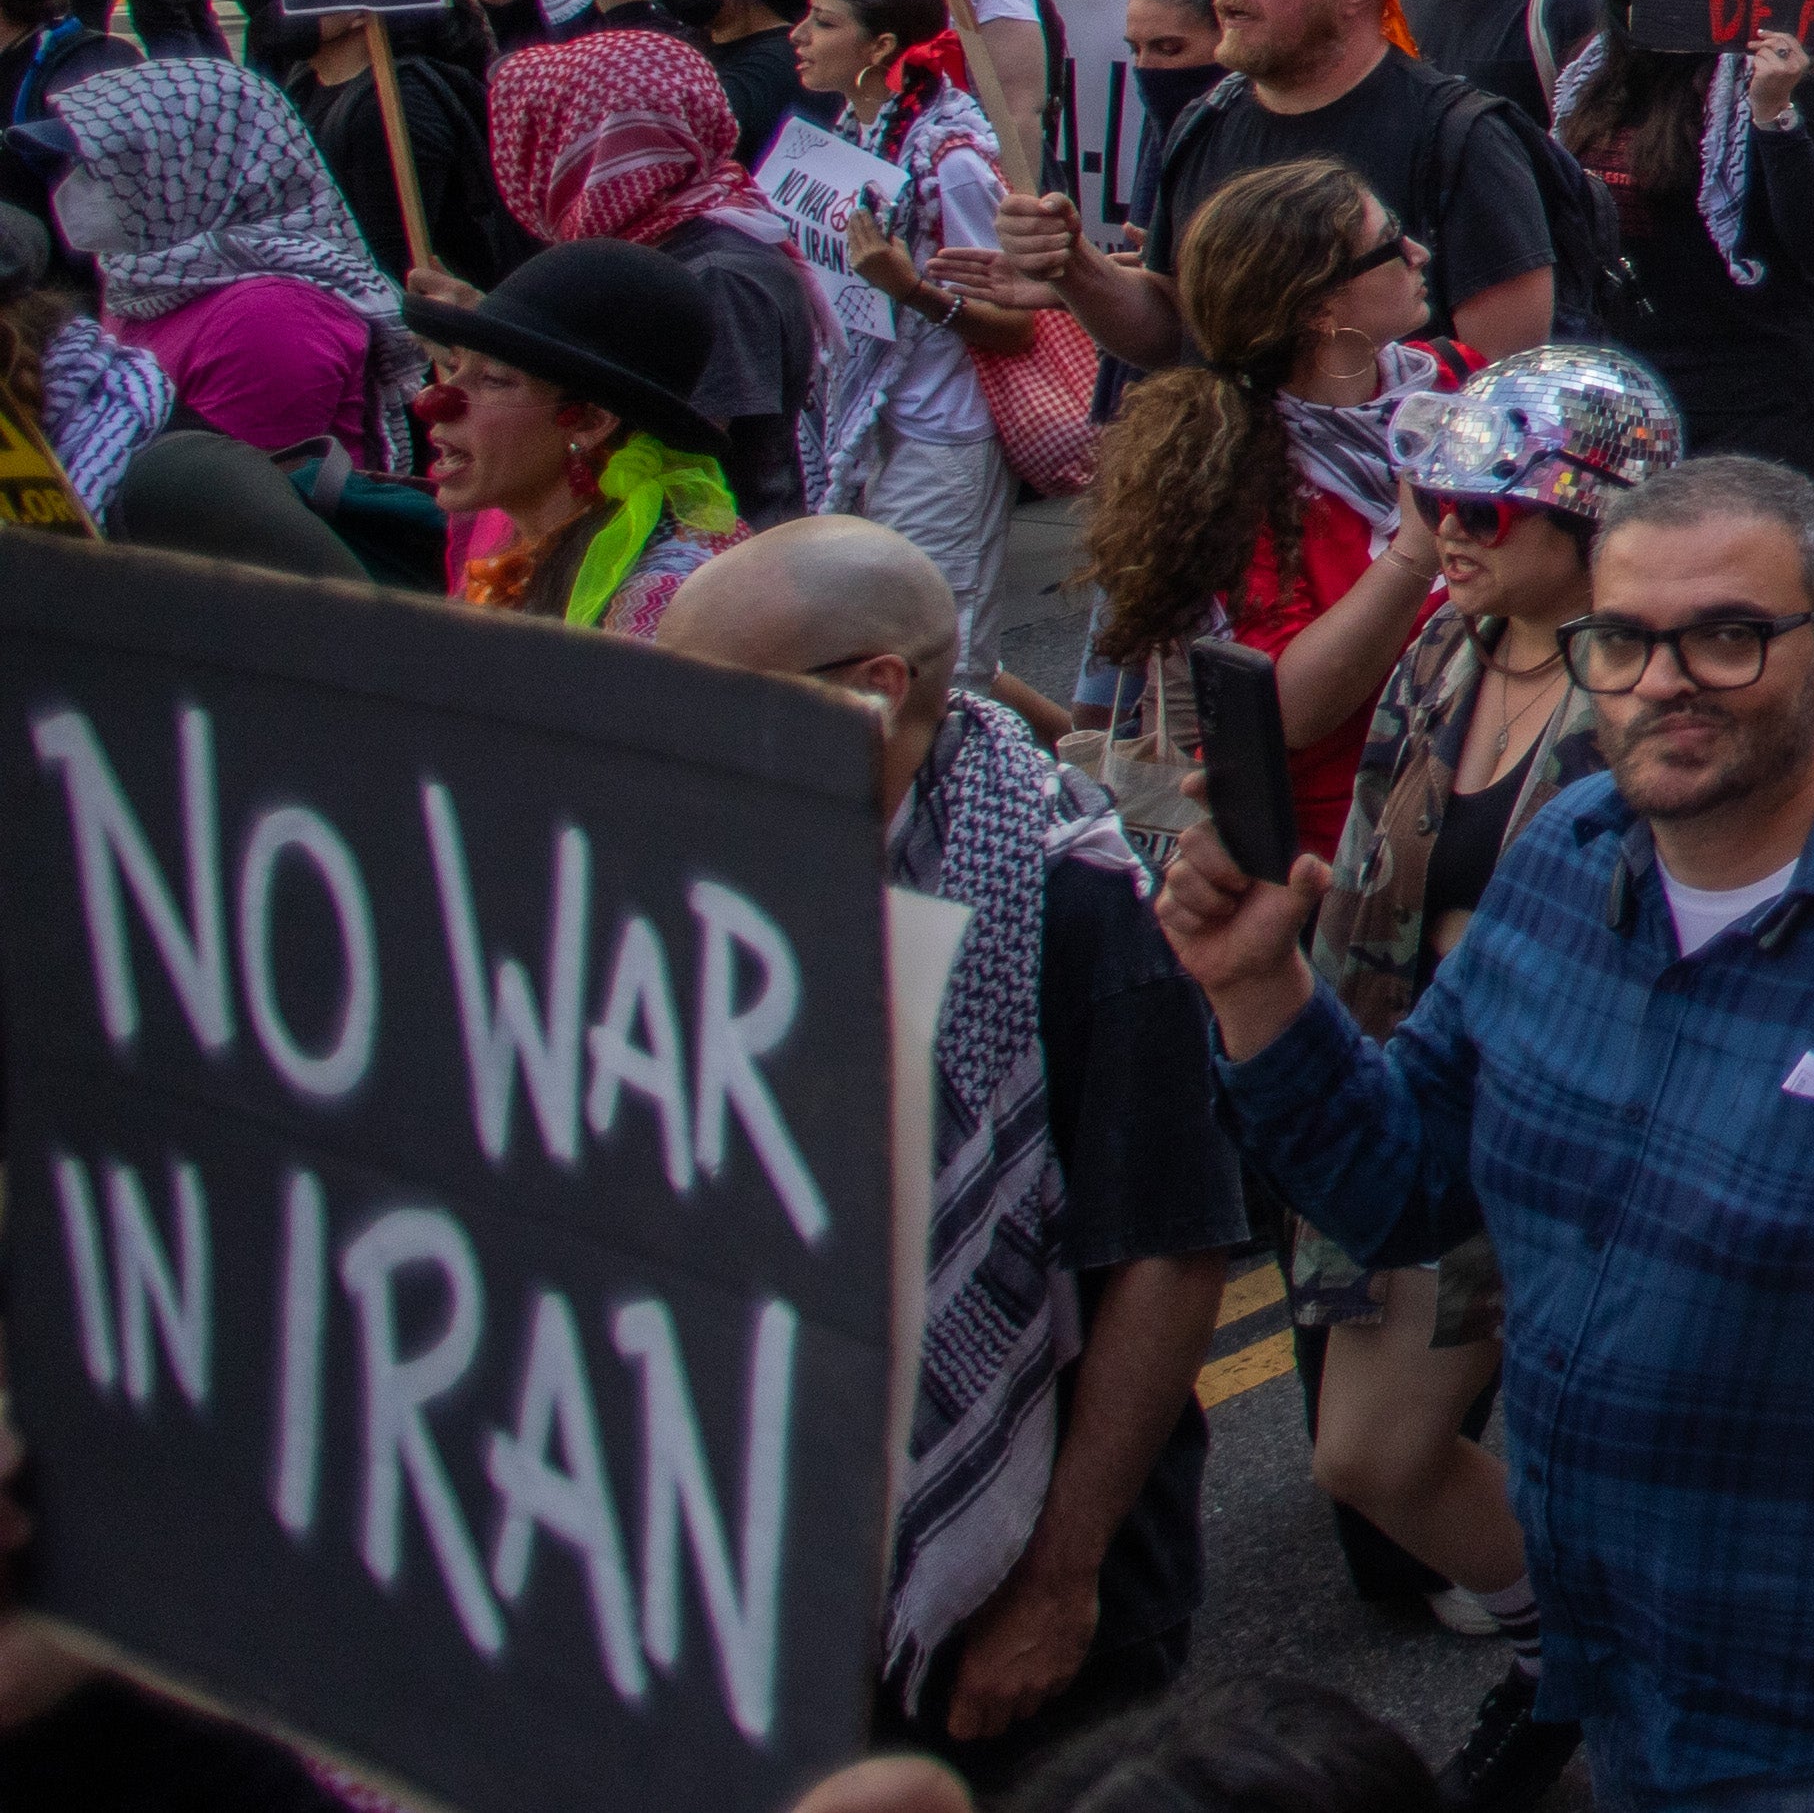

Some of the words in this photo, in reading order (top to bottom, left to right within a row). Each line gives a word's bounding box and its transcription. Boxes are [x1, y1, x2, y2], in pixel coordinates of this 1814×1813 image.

[771, 168, 808, 206] NO
[797, 178, 839, 225] WAR
[32, 706, 380, 1104] NO
[423, 781, 832, 1248] WAR
[50, 1154, 215, 1410] IN
[273, 1169, 802, 1748] IRAN
